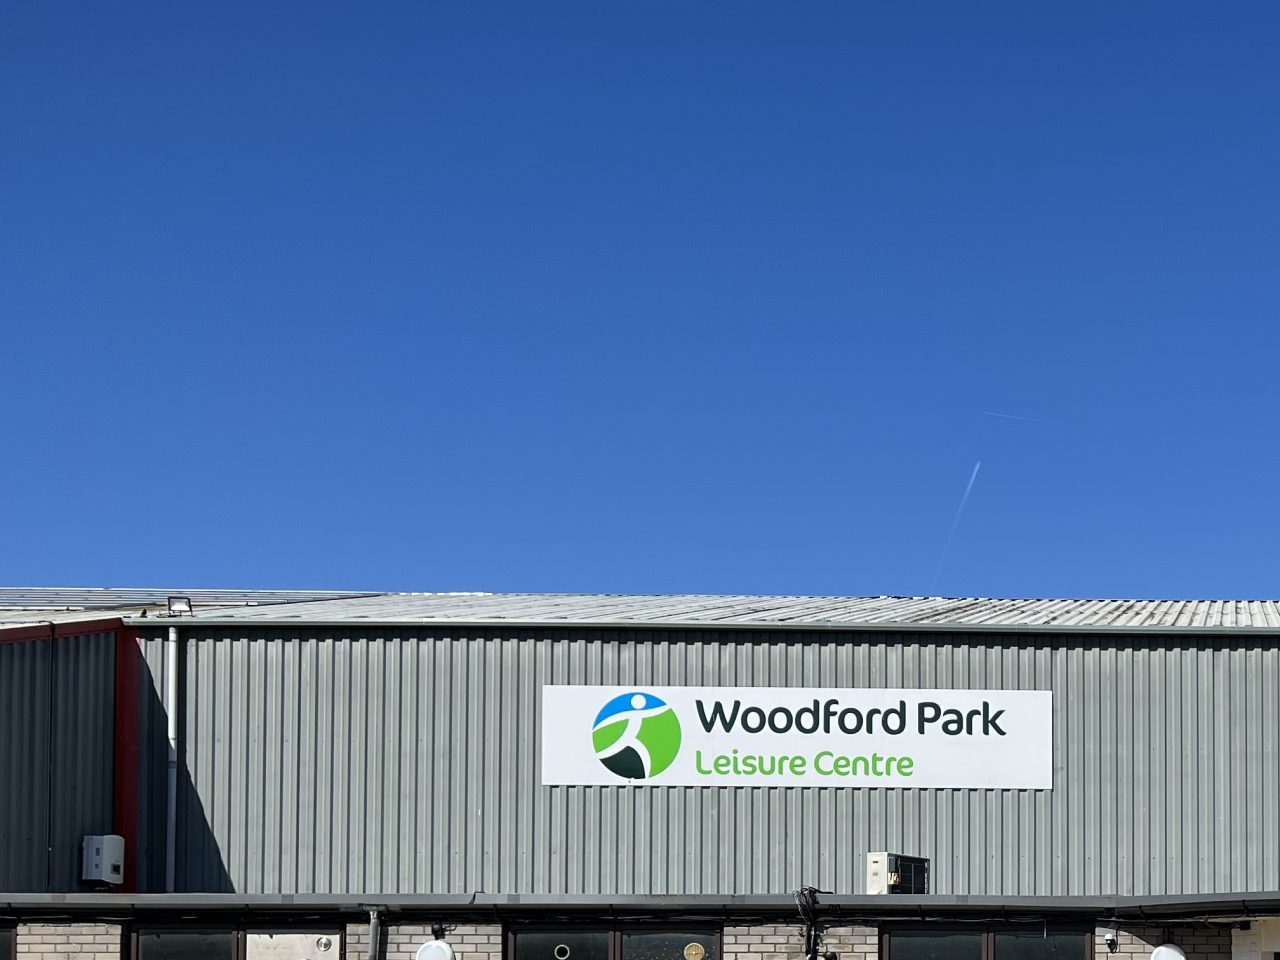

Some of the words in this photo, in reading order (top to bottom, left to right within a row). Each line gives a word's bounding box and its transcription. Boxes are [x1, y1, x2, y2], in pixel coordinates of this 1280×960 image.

[696, 699, 906, 735] Woodford
[918, 701, 1007, 736] Park
[696, 750, 806, 776] Leisure
[814, 751, 914, 777] Centre
